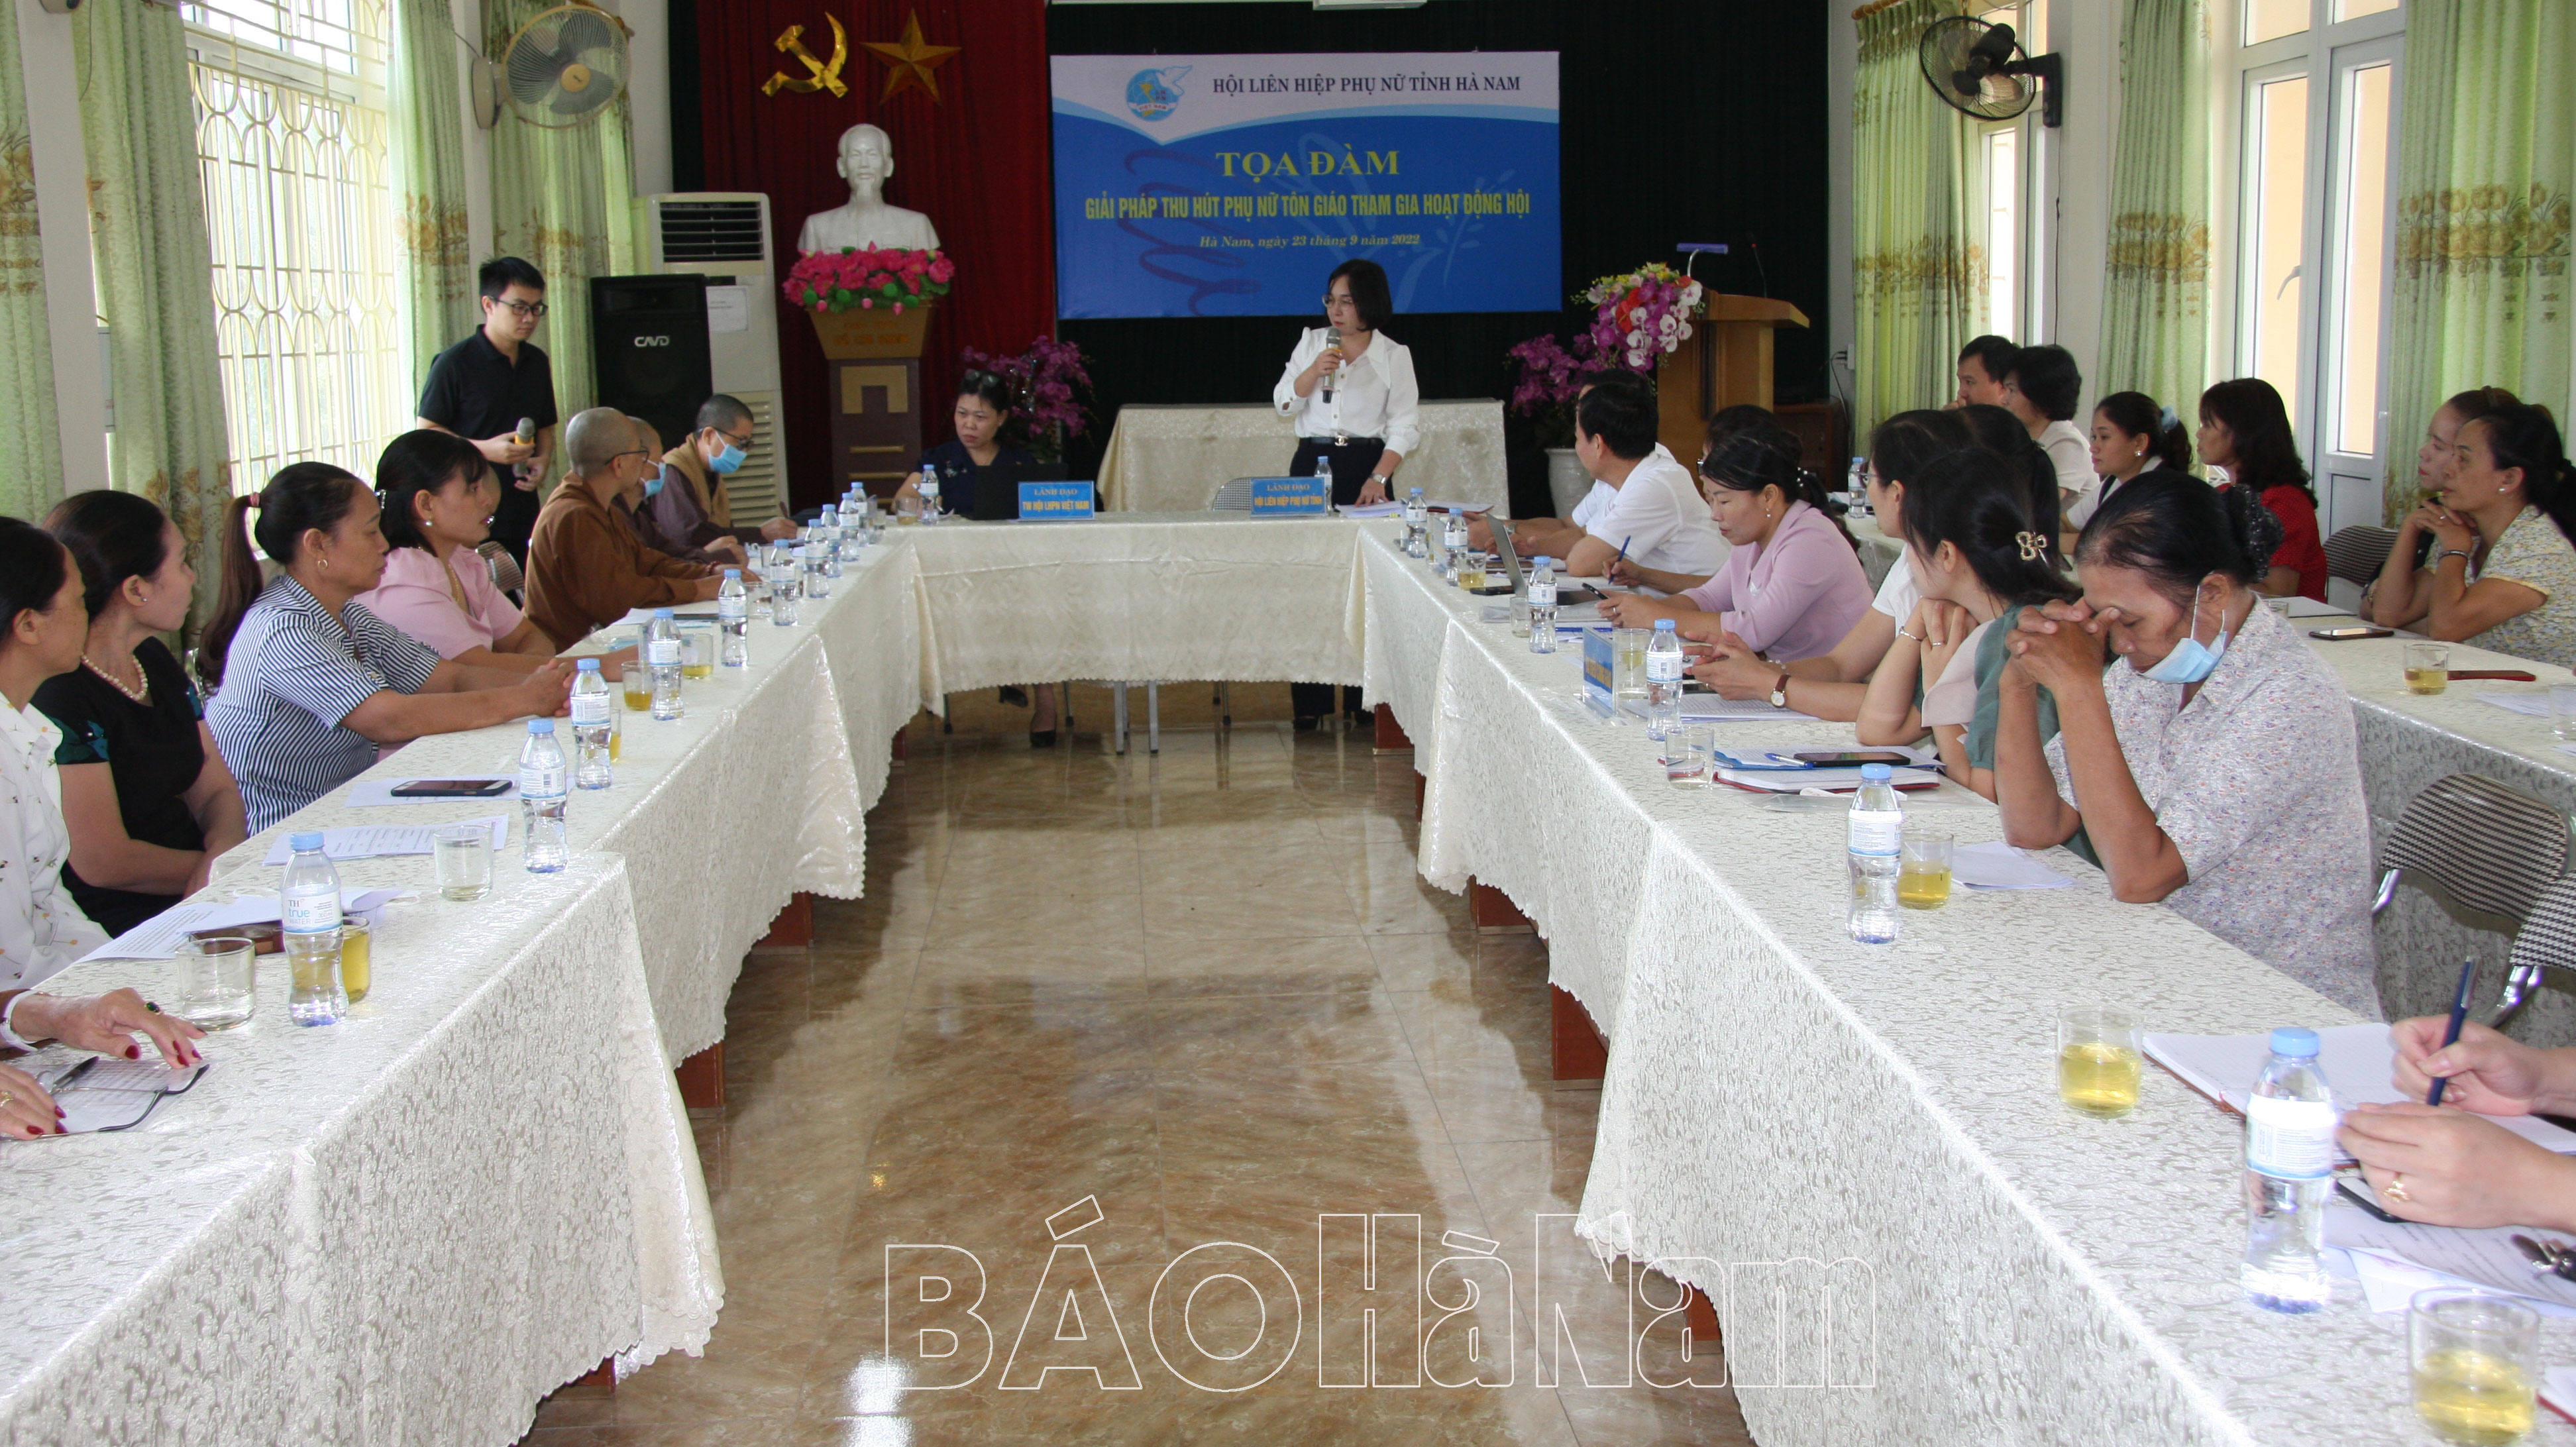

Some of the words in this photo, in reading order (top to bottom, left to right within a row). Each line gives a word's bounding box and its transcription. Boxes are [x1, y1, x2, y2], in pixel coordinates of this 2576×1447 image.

[1213, 74, 1244, 97] HỘI
[1250, 74, 1289, 92] LIÊN
[1295, 74, 1336, 95] HIỆP
[1340, 77, 1375, 95] PHỤ
[1381, 73, 1406, 91] NỮ
[1409, 72, 1450, 91] TỈNH
[1456, 72, 1479, 91] HÀ
[1483, 76, 1521, 91] NAM
[1216, 152, 1299, 183] TỌA
[1308, 143, 1399, 175] ĐÀM
[1085, 191, 1114, 219] GIẢI
[1118, 193, 1157, 219] PHÁP
[1161, 197, 1189, 218] THU
[1193, 192, 1220, 217] HÚT
[1224, 196, 1253, 222] PHỤ
[1257, 191, 1279, 217] NỮ
[1281, 191, 1309, 217] TÔN
[1314, 191, 1347, 216] GIÁO
[1351, 195, 1391, 215] THAM
[1395, 194, 1420, 215] GIA
[1423, 193, 1460, 219] HOẠT
[1464, 189, 1502, 219] ĐỘNG
[1506, 189, 1530, 219] HỘI
[1200, 235, 1218, 247] Hà
[1223, 236, 1254, 248] Nam,
[1258, 236, 1289, 248] ngày
[1291, 235, 1308, 246] 23
[1310, 235, 1348, 248] tháng
[1350, 235, 1359, 246] 9
[1361, 235, 1389, 245] năm
[1391, 234, 1421, 244] 2022
[288, 908, 310, 918] true
